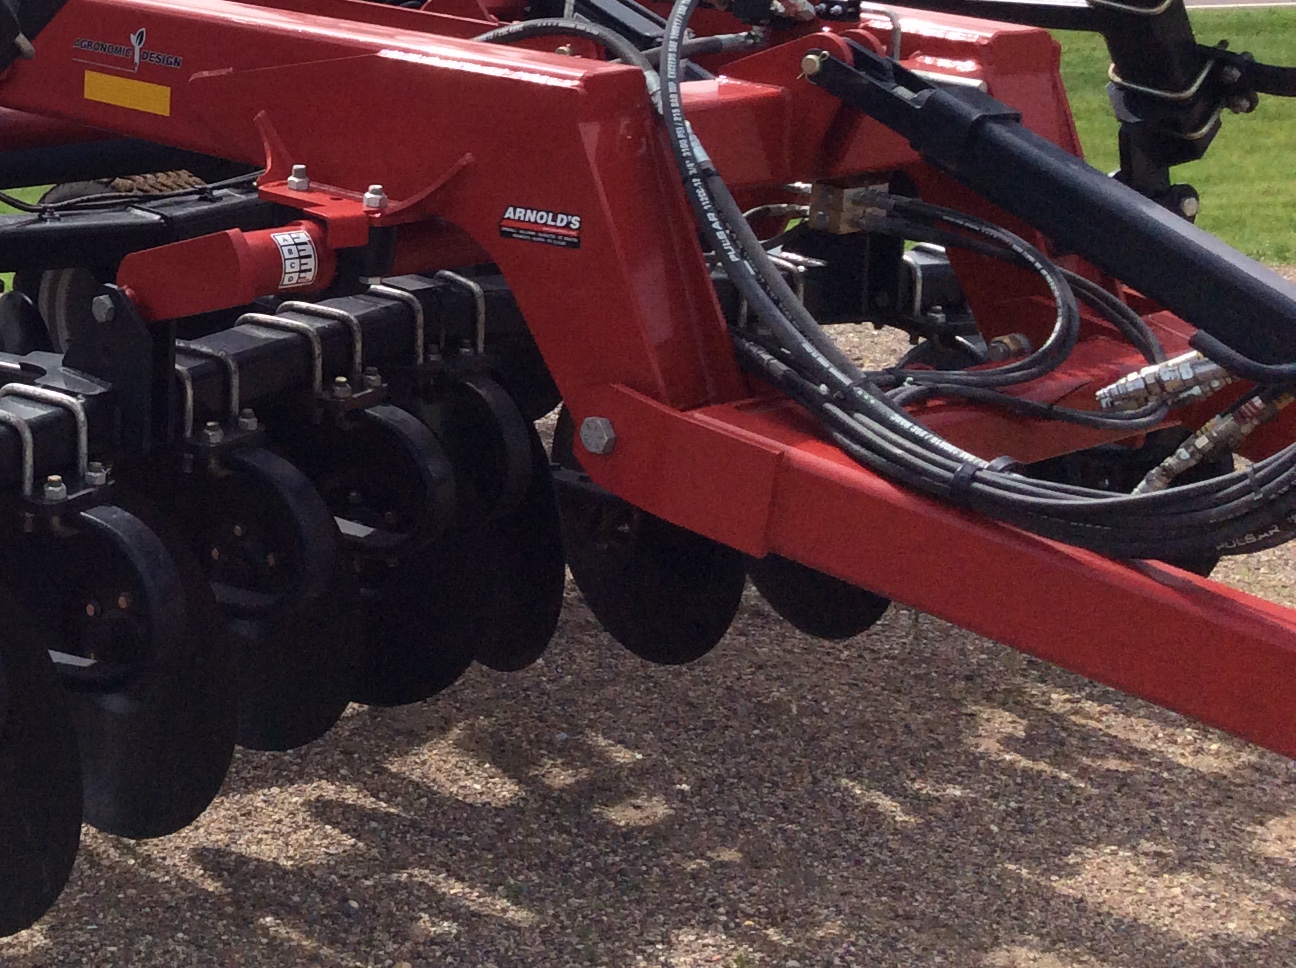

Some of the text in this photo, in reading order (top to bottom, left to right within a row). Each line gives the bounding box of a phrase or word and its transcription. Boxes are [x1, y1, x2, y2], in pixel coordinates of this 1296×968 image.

[72, 38, 183, 68] AGRONOMIC DESIGN
[503, 206, 581, 229] ARNOLD'S
